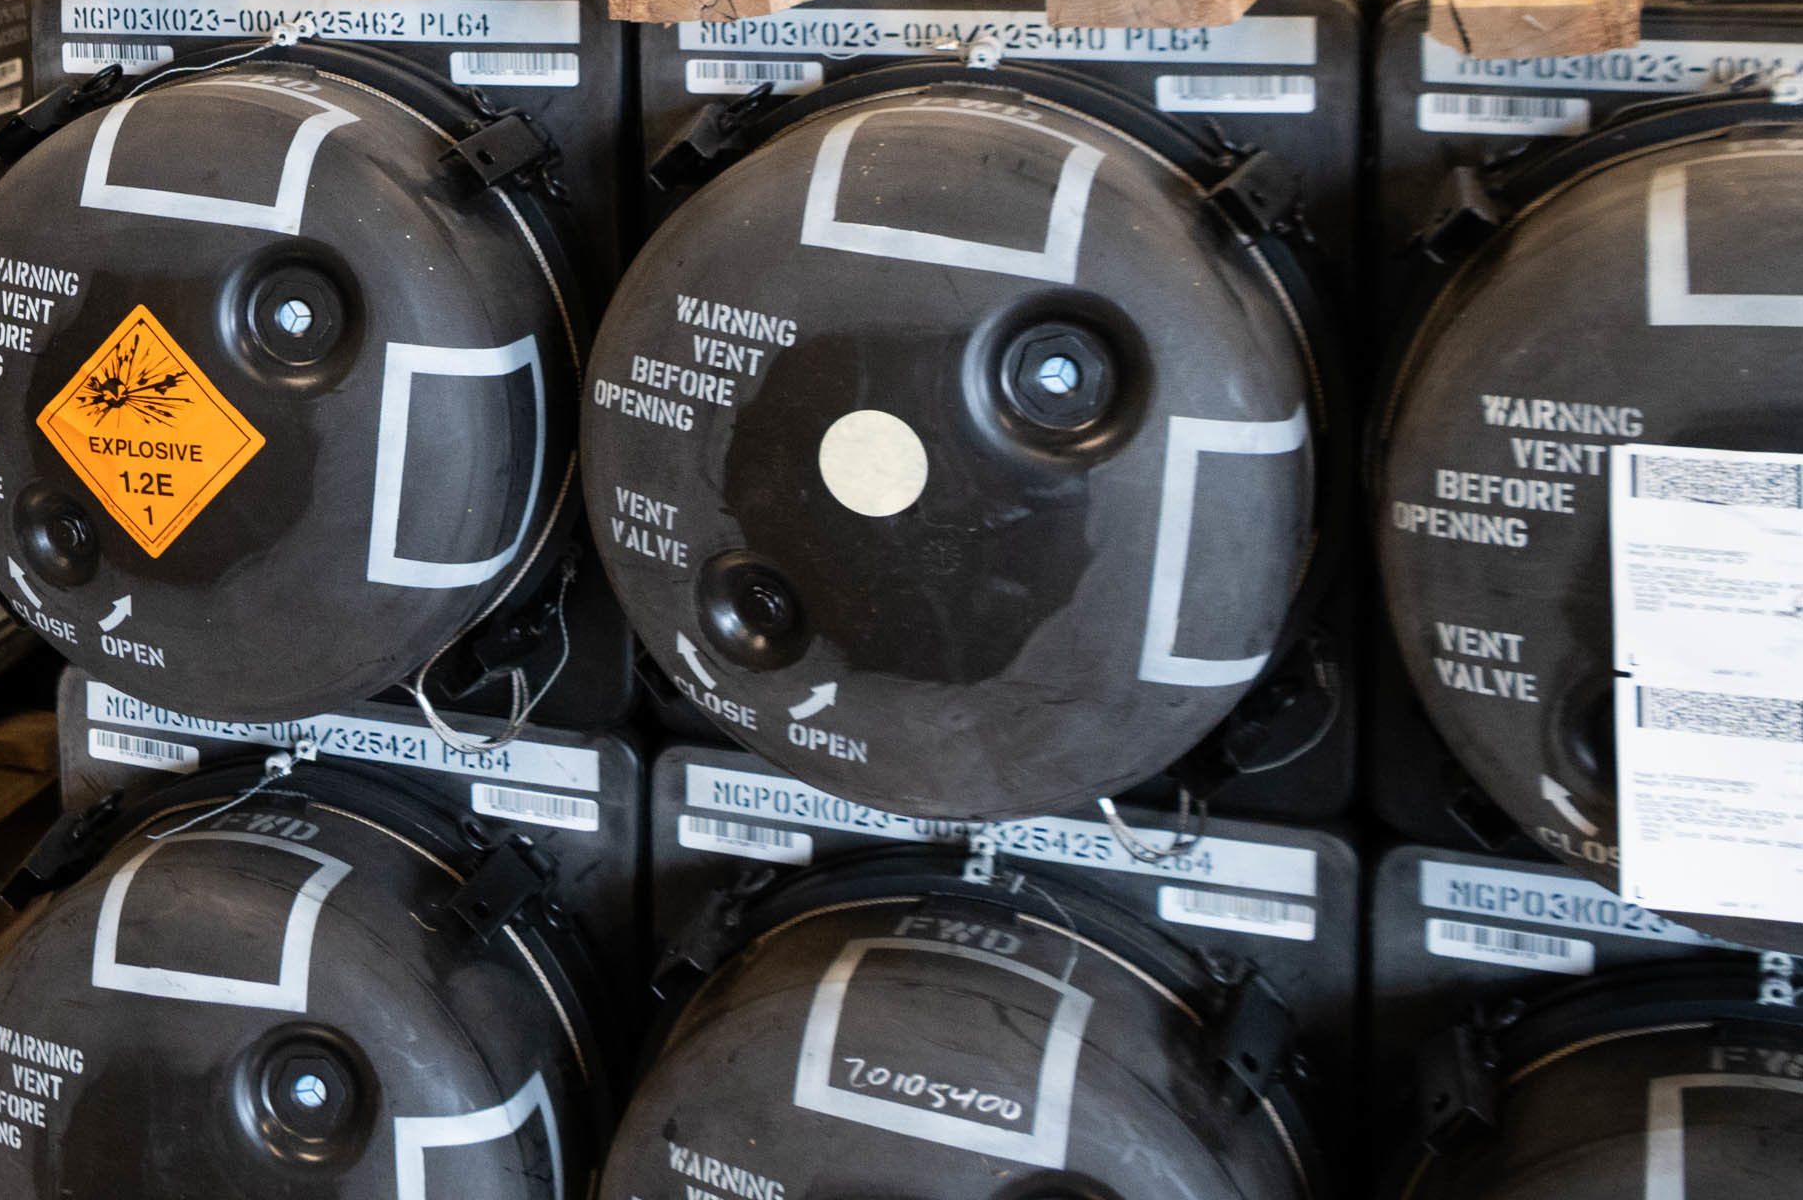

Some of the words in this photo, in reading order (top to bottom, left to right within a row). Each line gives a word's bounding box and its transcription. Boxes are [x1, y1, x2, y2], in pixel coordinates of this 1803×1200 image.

[419, 12, 491, 37] PL64
[1125, 27, 1212, 52] PL64
[1, 290, 55, 325] VENT
[677, 294, 798, 348] WARNING
[693, 335, 765, 377] VENT
[631, 354, 736, 408] BEFORE
[594, 378, 695, 432] OPENING
[1481, 394, 1644, 438] WARNING
[88, 435, 204, 463] EXPLOSIVE
[1511, 437, 1607, 476] VENT
[118, 471, 175, 498] 1.2E
[1436, 468, 1576, 514] BEFORE
[142, 505, 154, 526] 1
[615, 486, 679, 532] VENT
[1395, 501, 1529, 548] OPENING
[611, 518, 689, 569] VALVE
[11, 597, 79, 645] CLOSE
[1435, 621, 1526, 664] VENT
[101, 633, 166, 669] OPEN
[1433, 657, 1540, 703] VALVE
[674, 674, 759, 732] CLOSE
[788, 722, 869, 765] OPEN
[892, 915, 1025, 956] FWD
[12, 1063, 64, 1101] VENT
[668, 1141, 785, 1200] WARNING
